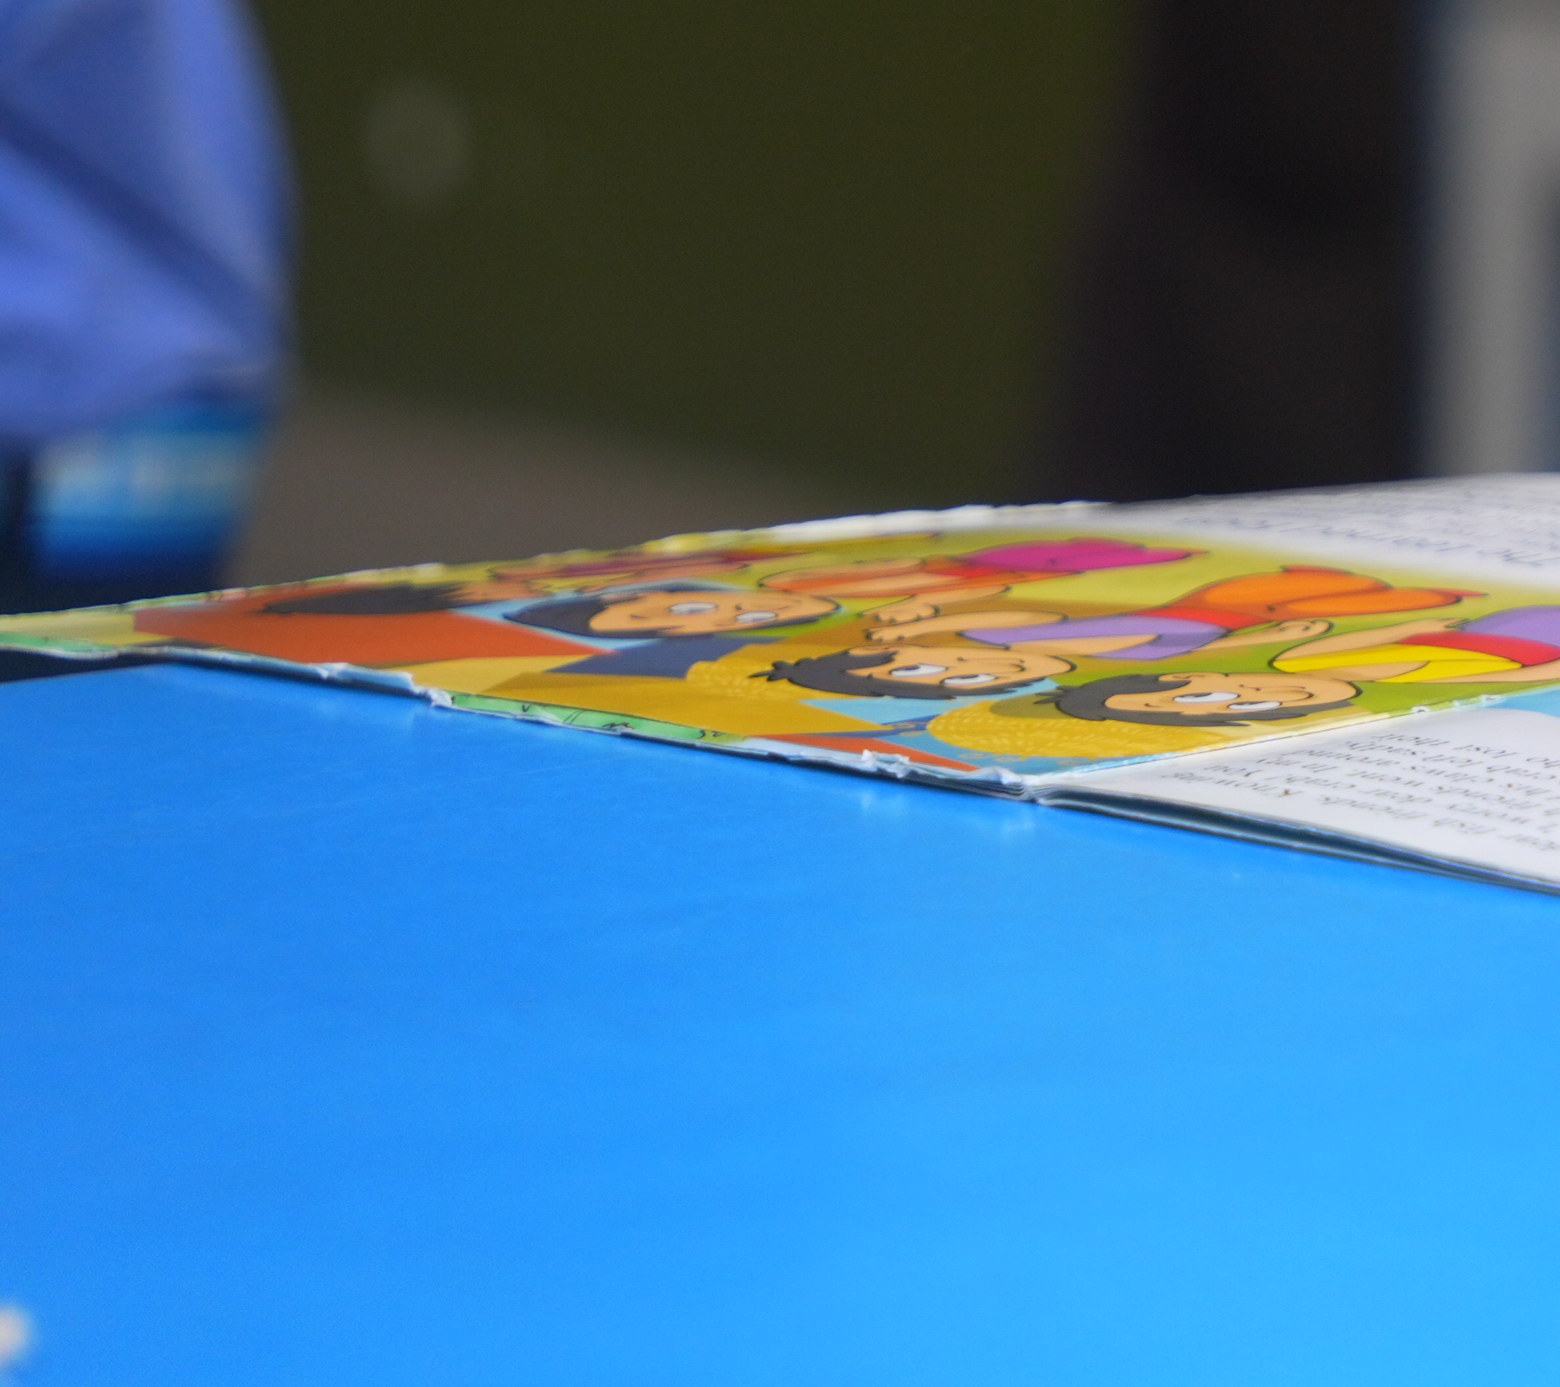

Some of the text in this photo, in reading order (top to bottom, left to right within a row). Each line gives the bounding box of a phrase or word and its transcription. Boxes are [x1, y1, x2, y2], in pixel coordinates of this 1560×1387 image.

[1370, 733, 1449, 746] their
[1280, 749, 1399, 766] around
[1453, 743, 1517, 758] lost
[1255, 756, 1300, 766] my
[1300, 762, 1338, 773] In
[1421, 753, 1483, 768] left
[1203, 764, 1262, 777] You
[1402, 765, 1494, 783] claws
[1485, 765, 1556, 780] crab
[1160, 772, 1301, 797] Knowing
[1499, 782, 1550, 796] his
[1358, 788, 1433, 803] dear
[1430, 785, 1540, 809] friends
[1446, 803, 1530, 824] worry
[1432, 817, 1496, 835] fish
